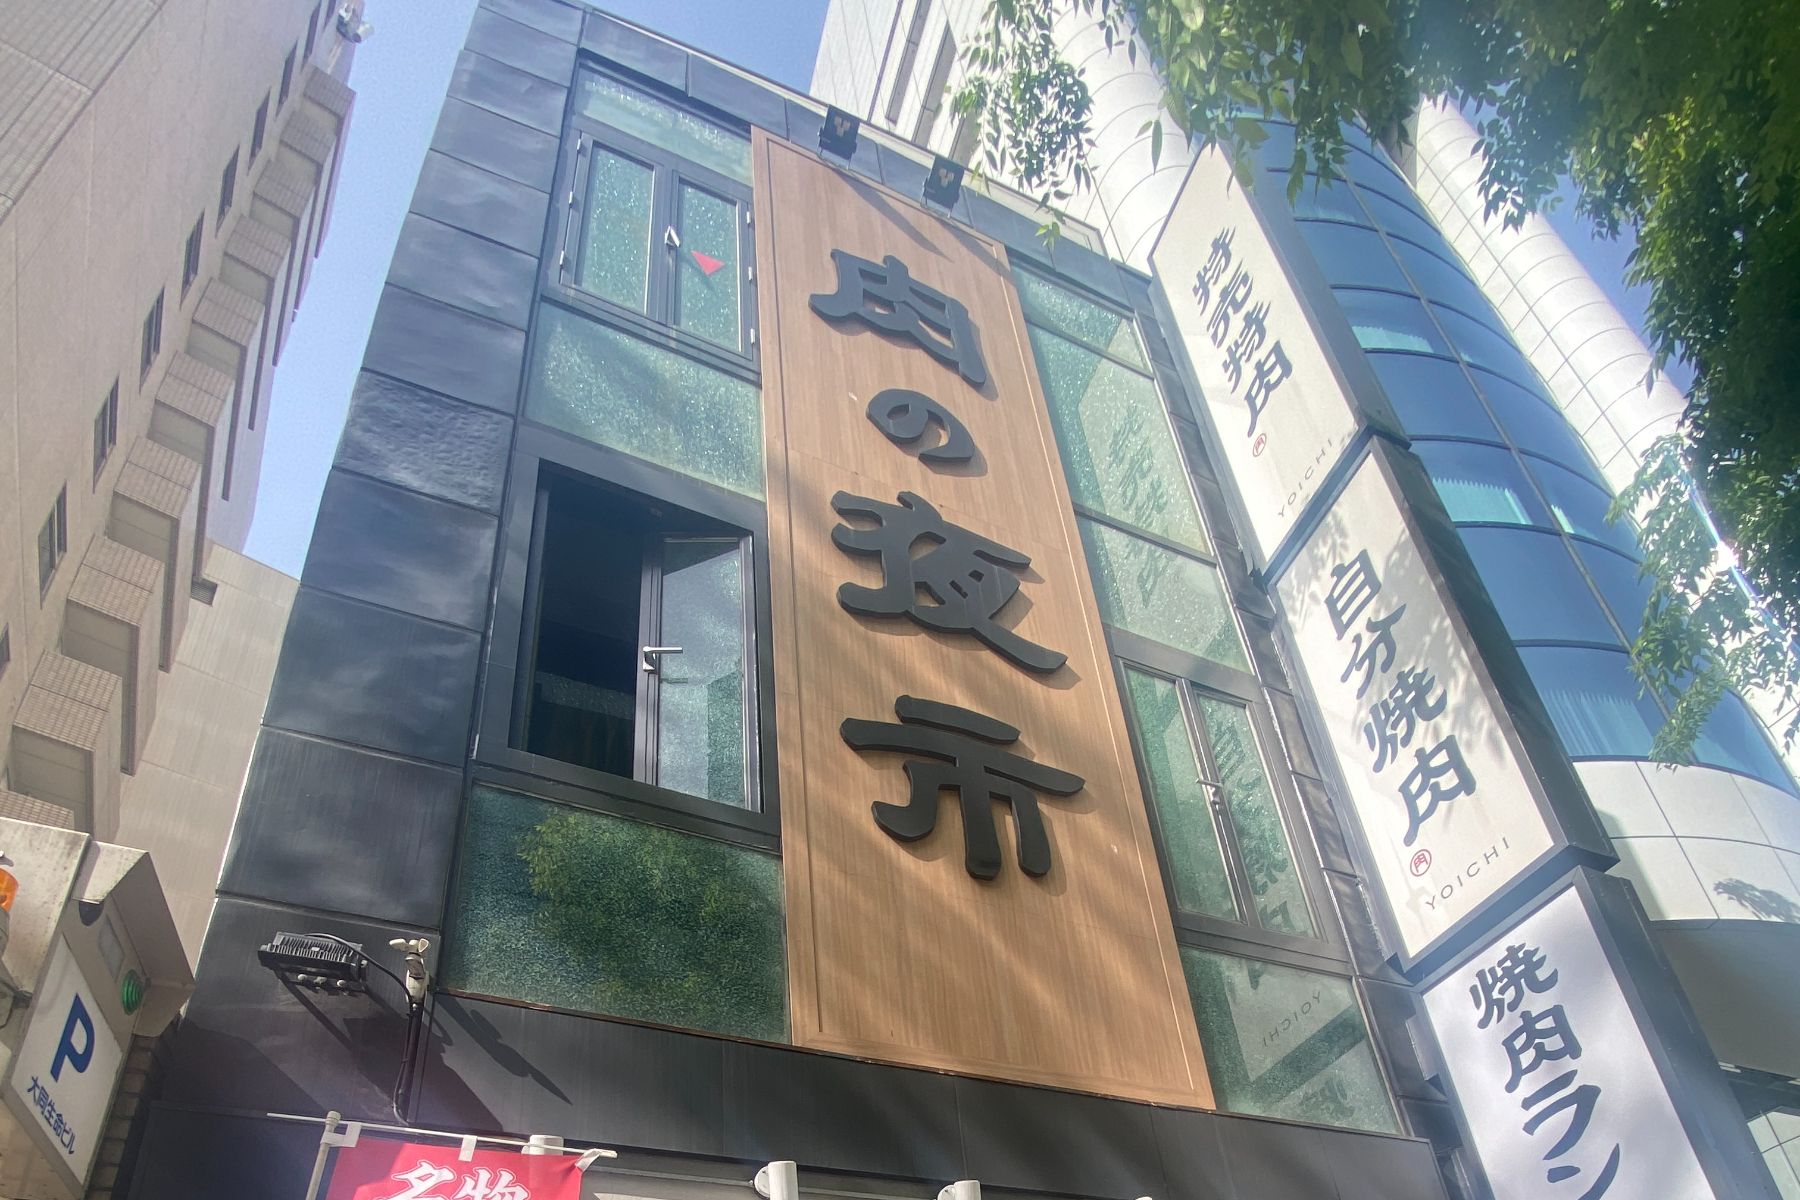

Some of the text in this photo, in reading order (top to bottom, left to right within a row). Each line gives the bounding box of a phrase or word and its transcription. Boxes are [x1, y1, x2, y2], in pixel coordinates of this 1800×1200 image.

[1278, 438, 1332, 518] YOICHI
[809, 249, 1085, 882] 肉の夜市
[1324, 548, 1477, 847] 自分焼肉
[1425, 836, 1510, 911] YOICHI
[50, 992, 96, 1083] P
[27, 1075, 76, 1155] 大同生命ビル
